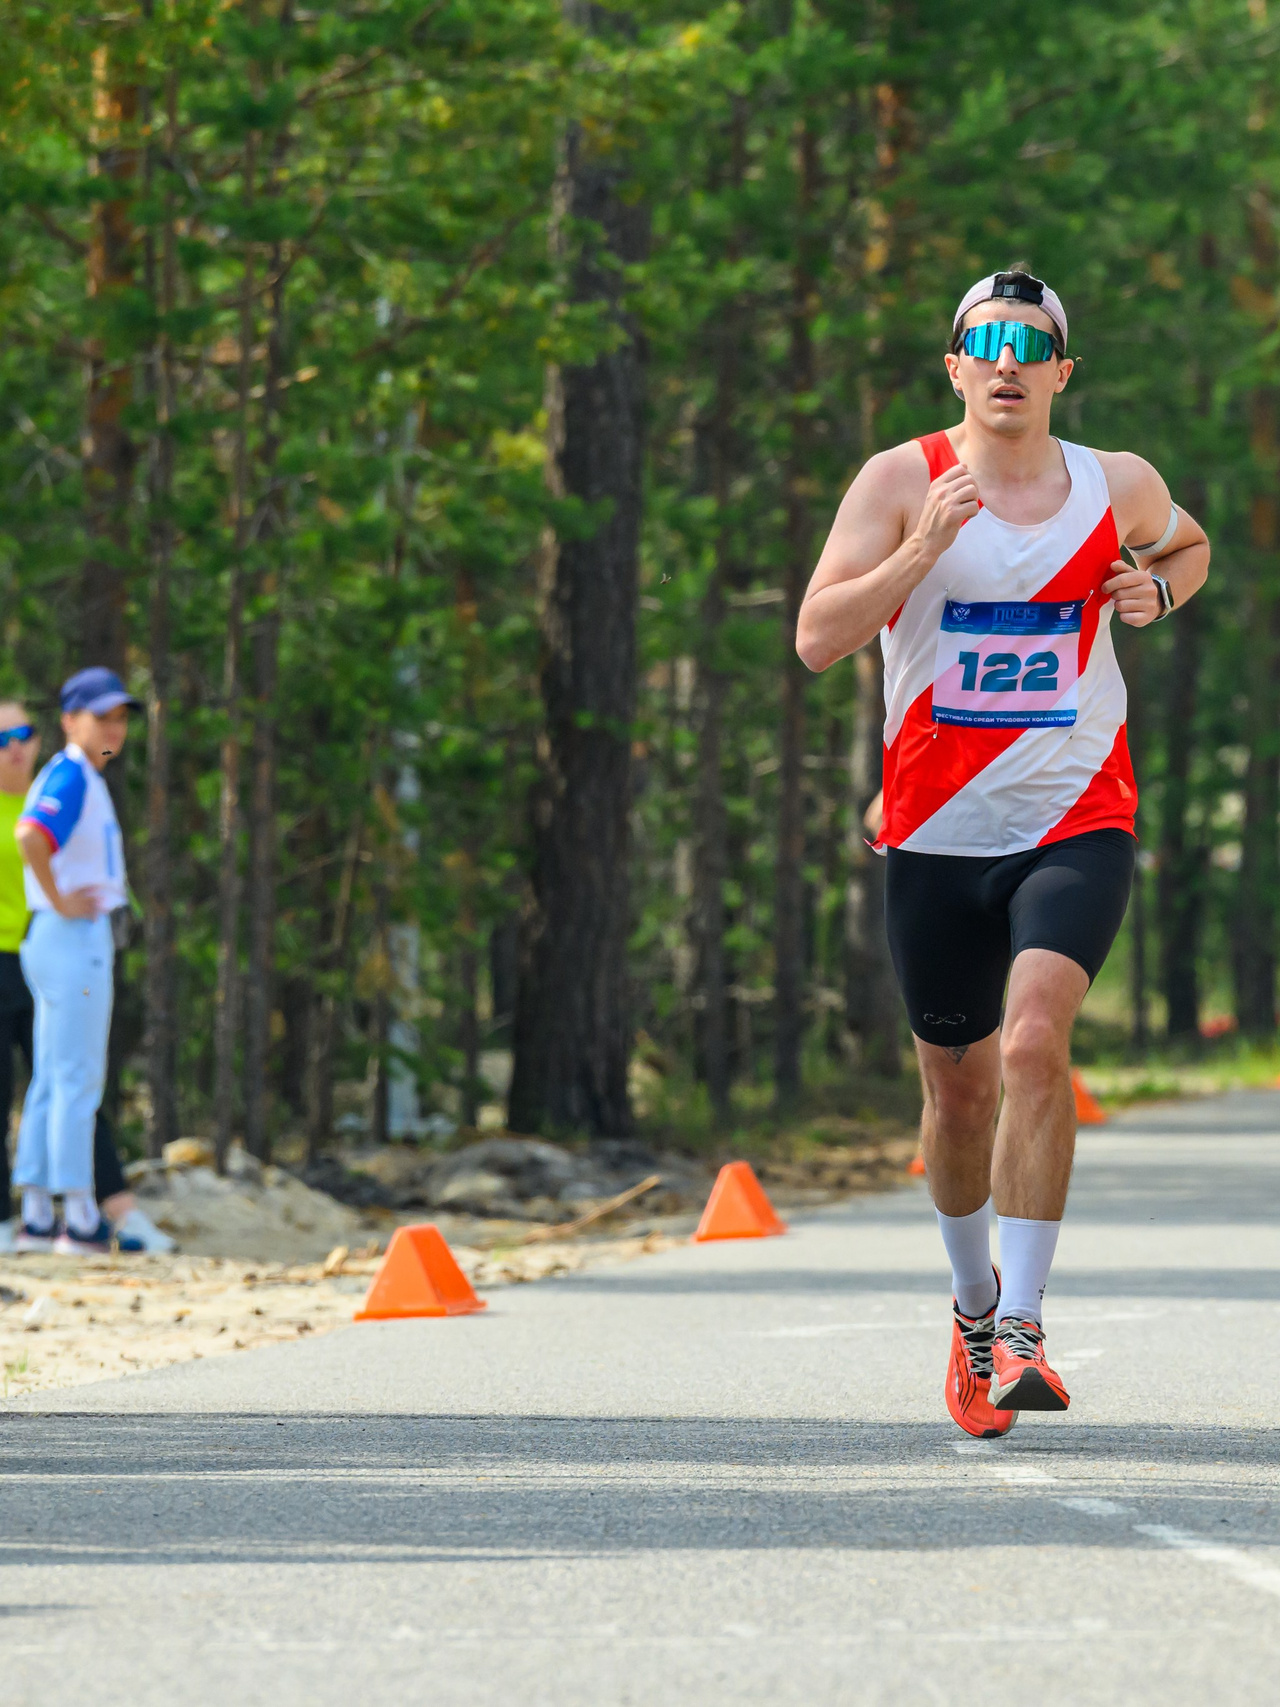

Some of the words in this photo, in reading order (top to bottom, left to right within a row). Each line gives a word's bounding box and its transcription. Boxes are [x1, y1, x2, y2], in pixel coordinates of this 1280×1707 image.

[958, 651, 1060, 692] 122
[935, 712, 972, 722] ФЕСТИВАЛЬ
[1031, 714, 1076, 723] КОЛЛЕКТИВОВ
